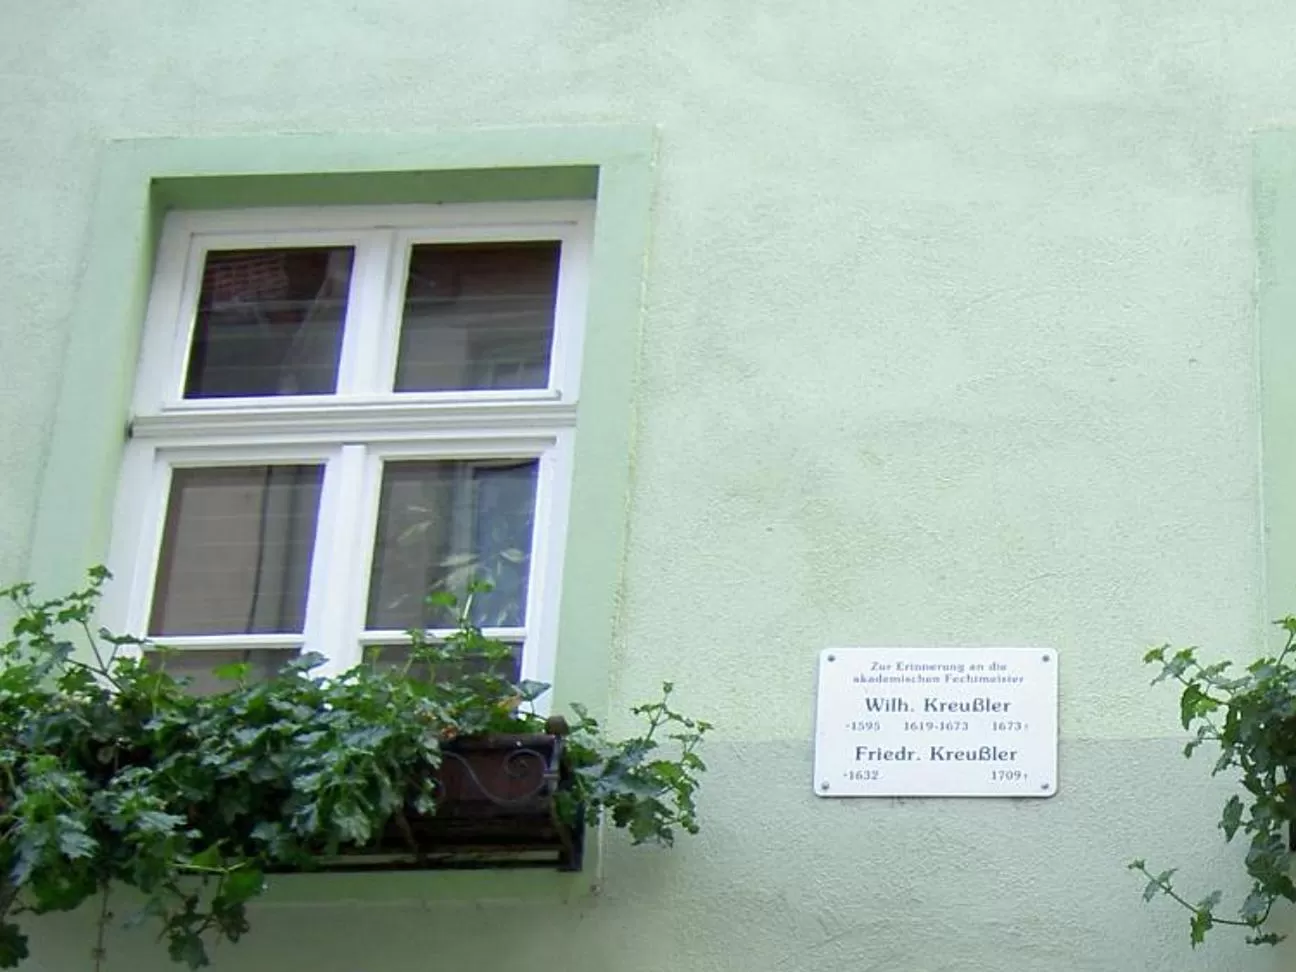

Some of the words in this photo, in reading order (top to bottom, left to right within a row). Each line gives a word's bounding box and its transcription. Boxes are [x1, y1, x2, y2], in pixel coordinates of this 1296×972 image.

[870, 661, 891, 672] Zur
[896, 661, 965, 672] Erinnerung
[969, 663, 984, 671] an
[989, 661, 1007, 671] die
[853, 674, 940, 684] akademischen
[945, 674, 1024, 684] Fechtmeister
[866, 698, 915, 713] Wilh.
[924, 697, 1011, 713] Kreußler
[904, 721, 968, 731] 1619-1673
[856, 746, 921, 761] Friedr.
[930, 746, 1018, 761] Kreußler
